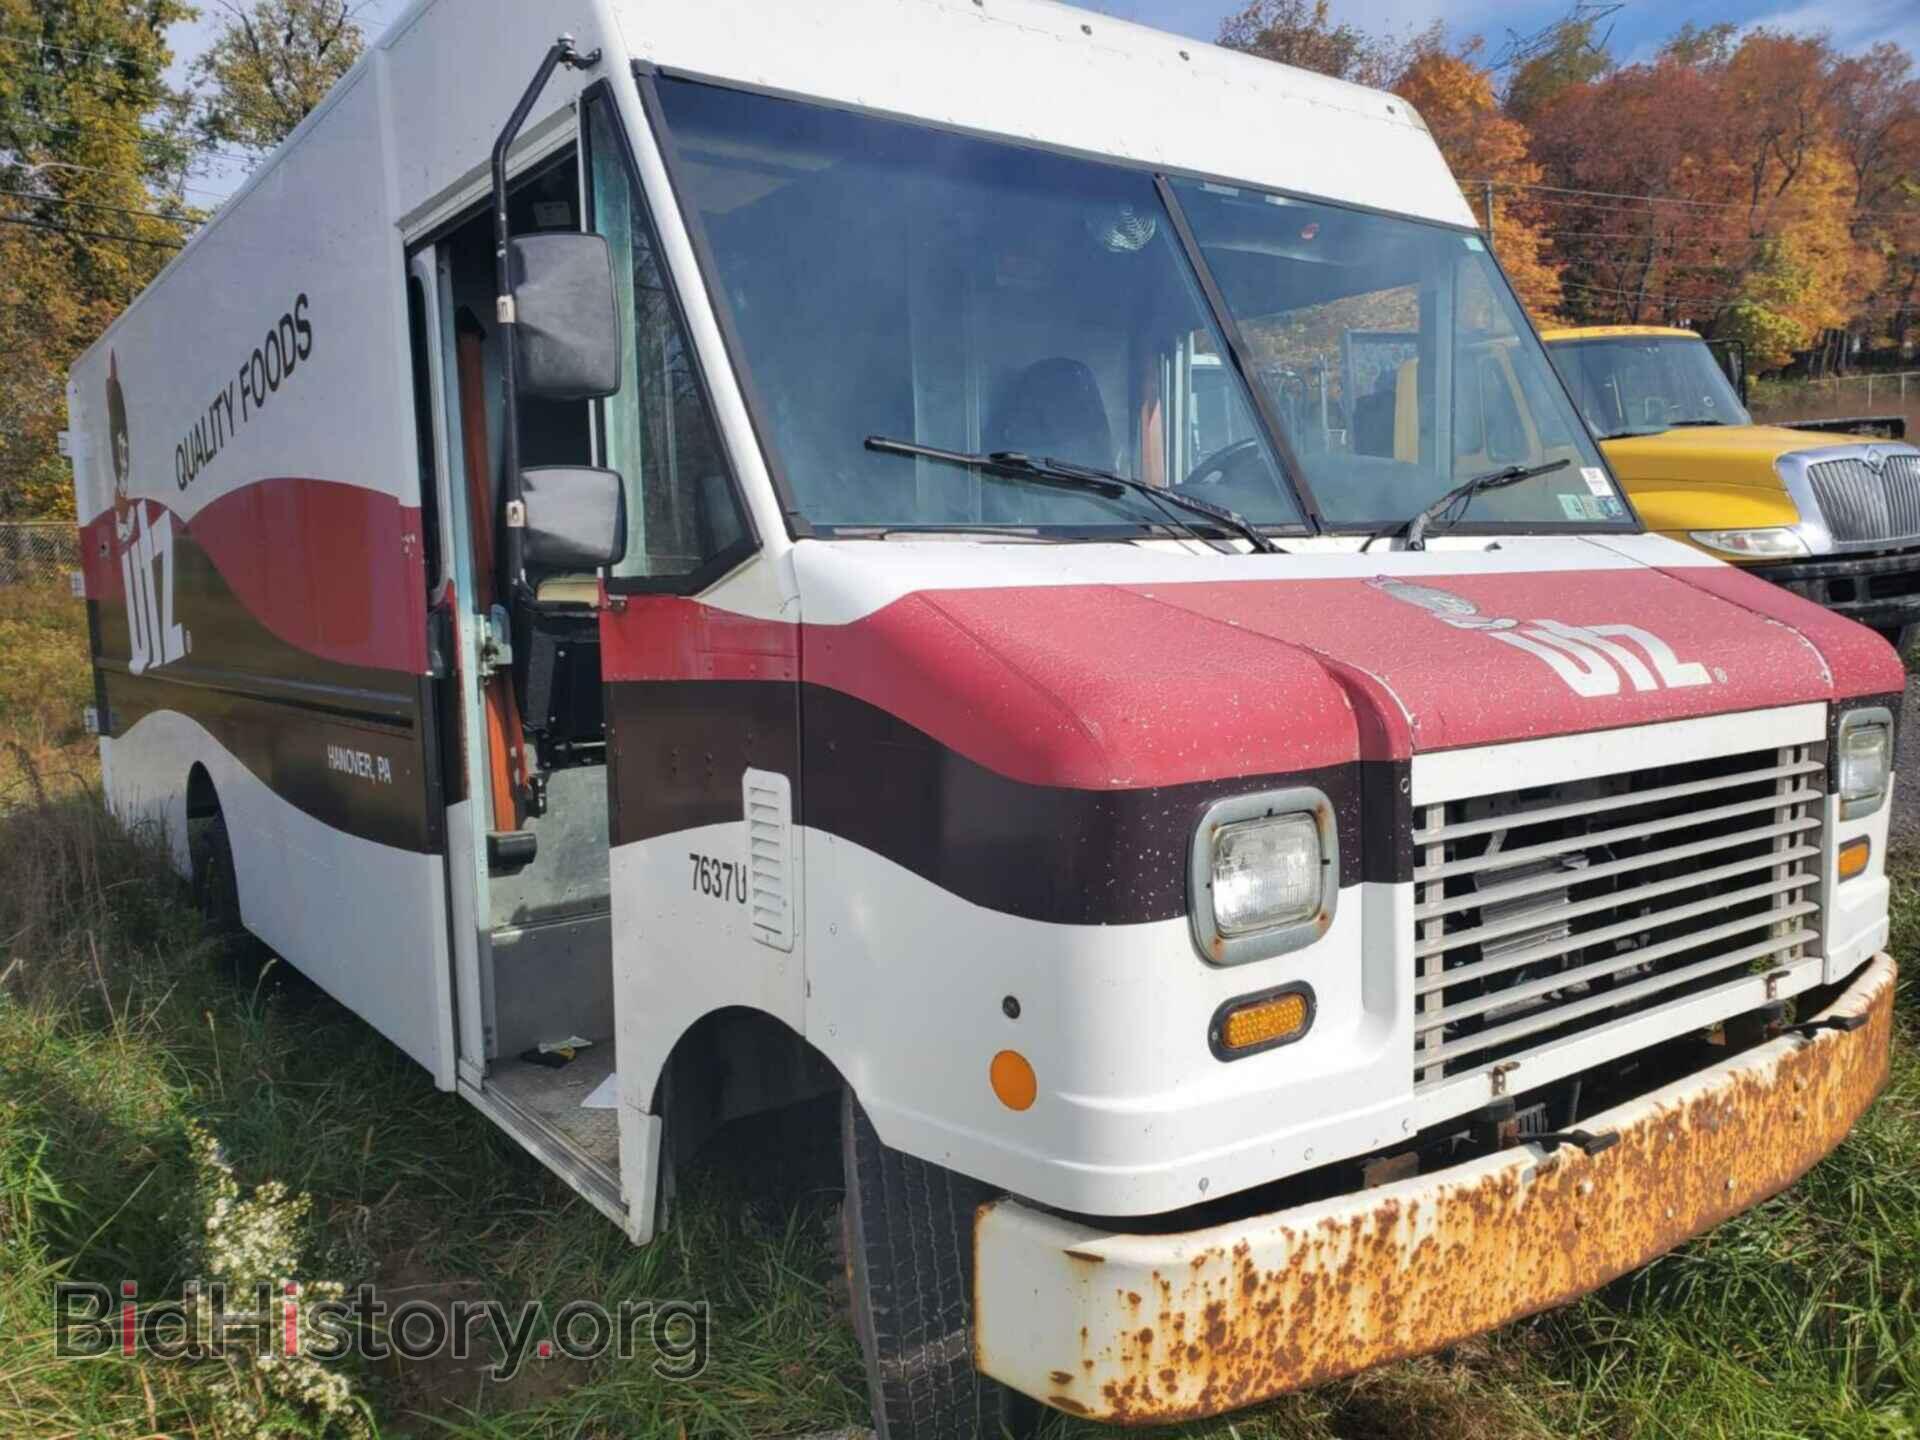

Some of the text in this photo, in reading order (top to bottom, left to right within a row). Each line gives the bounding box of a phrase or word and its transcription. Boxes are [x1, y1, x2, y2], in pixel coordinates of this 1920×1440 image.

[176, 292, 313, 491] QUALITY FOODS
[377, 755, 393, 785] PA
[689, 852, 747, 904] 7637U
